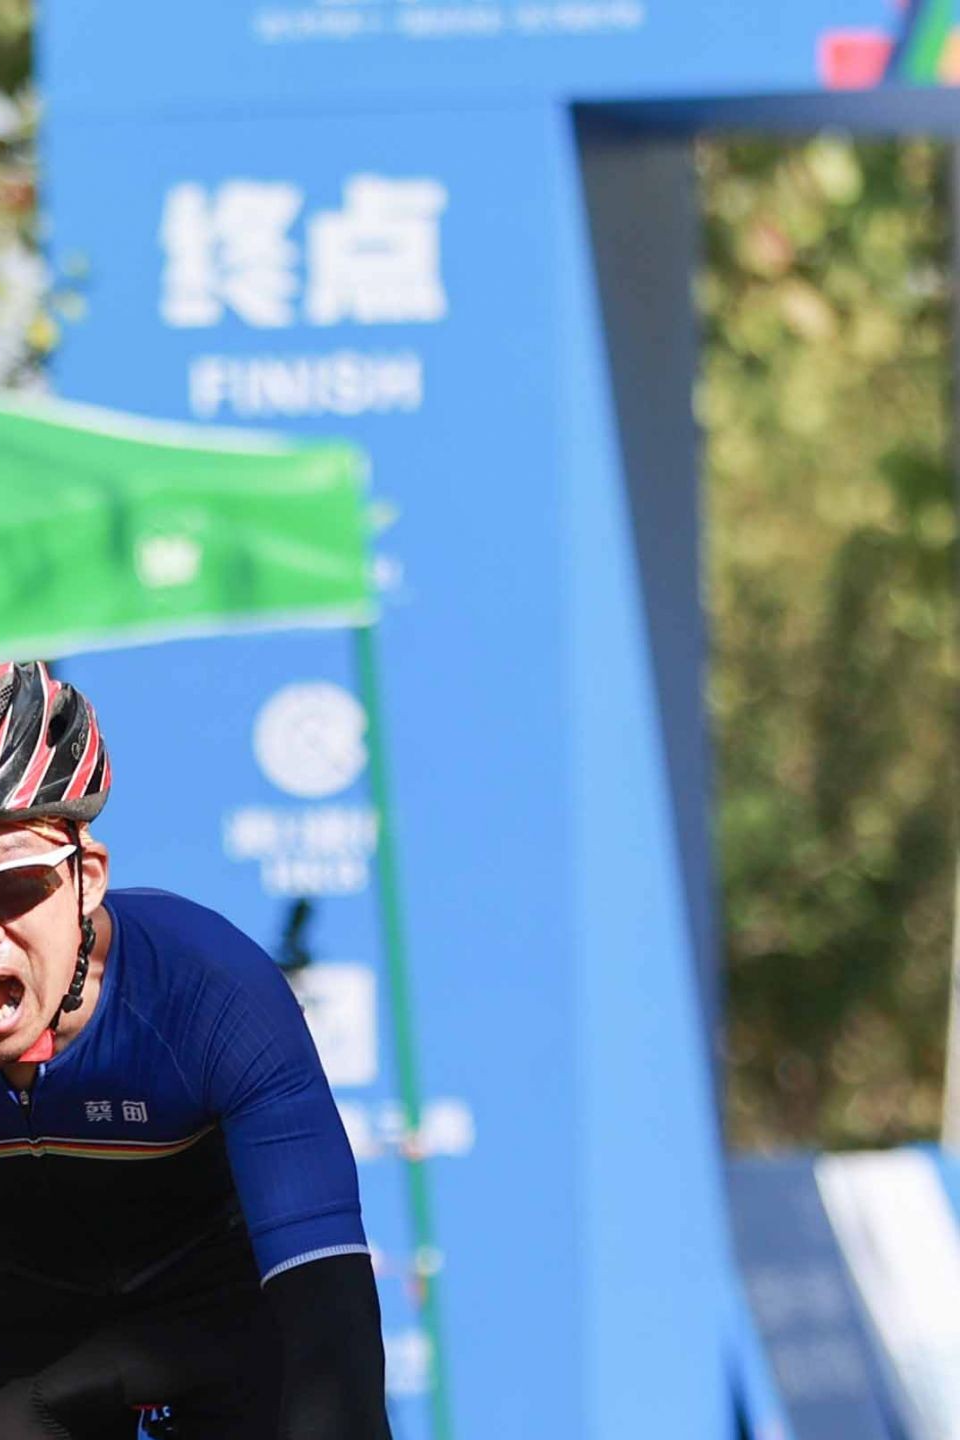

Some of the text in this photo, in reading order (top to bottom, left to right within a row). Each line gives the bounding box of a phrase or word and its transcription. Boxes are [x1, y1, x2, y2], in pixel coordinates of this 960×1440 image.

[161, 175, 448, 327] 终点
[190, 352, 422, 416] FINISH
[83, 1099, 149, 1124] 蔡甸
